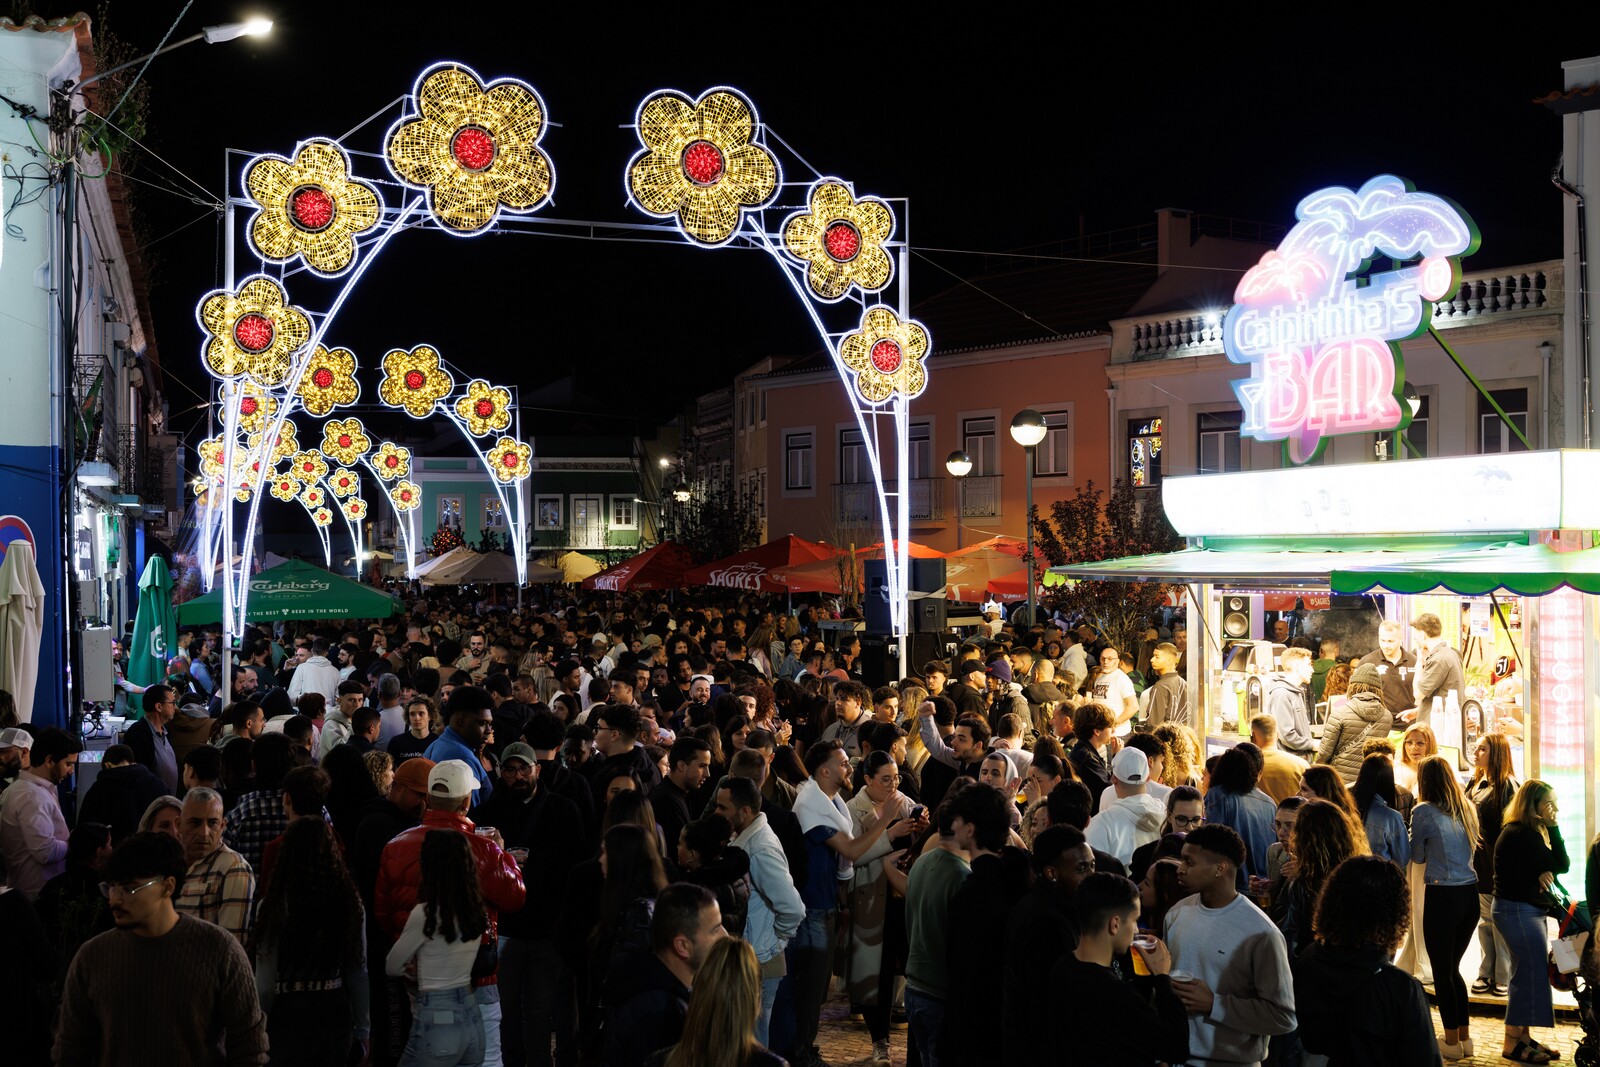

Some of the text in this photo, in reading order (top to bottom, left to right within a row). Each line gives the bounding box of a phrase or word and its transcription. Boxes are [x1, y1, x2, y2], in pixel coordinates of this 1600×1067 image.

[1265, 340, 1401, 433] BAR
[248, 579, 331, 594] Carlsberg
[593, 576, 619, 592] SAGRES
[707, 569, 767, 591] SAGRES
[1496, 657, 1508, 675] 51
